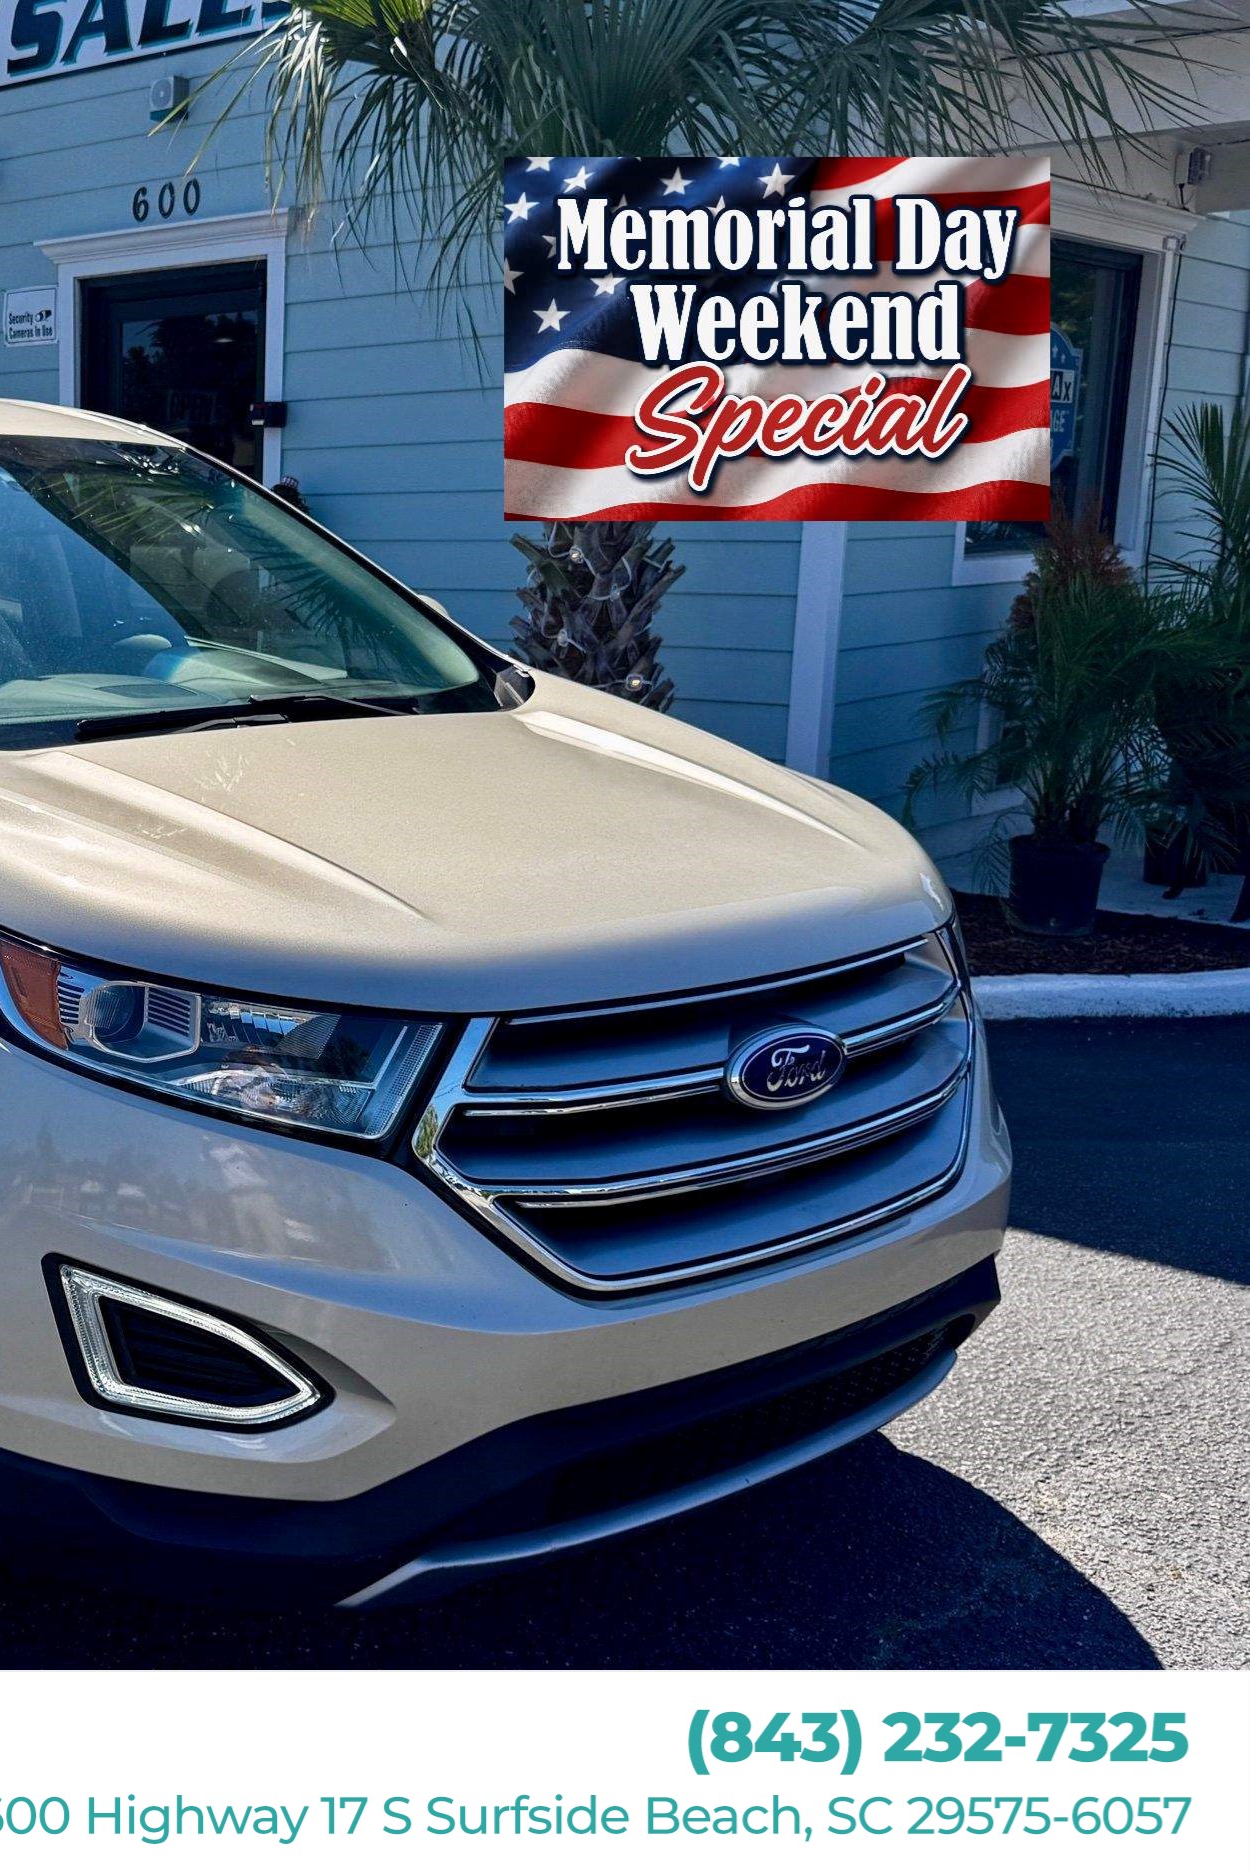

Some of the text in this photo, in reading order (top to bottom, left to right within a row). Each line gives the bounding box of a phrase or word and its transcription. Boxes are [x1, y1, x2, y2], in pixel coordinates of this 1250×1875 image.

[6, 0, 295, 77] SAL
[132, 178, 200, 223] 600
[8, 310, 34, 325] Security
[8, 325, 34, 339] Cameras
[41, 324, 53, 337] Use
[766, 1044, 827, 1092] Ford
